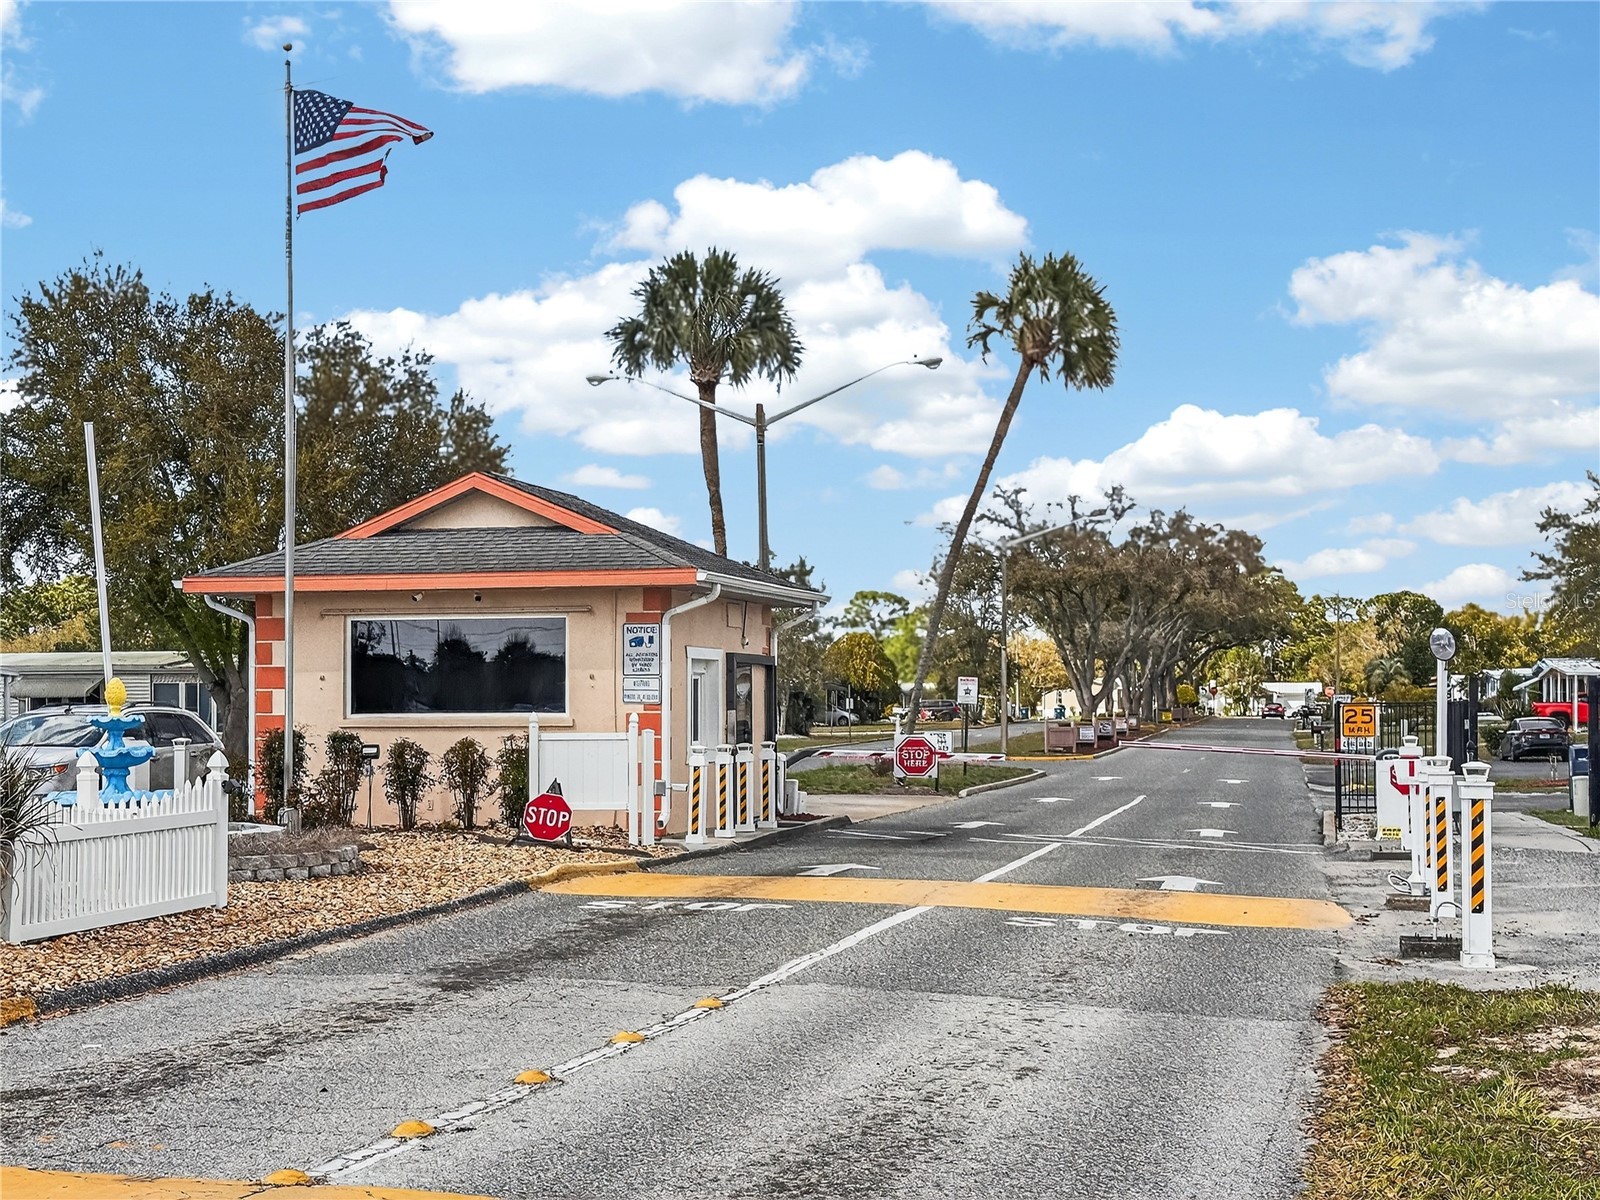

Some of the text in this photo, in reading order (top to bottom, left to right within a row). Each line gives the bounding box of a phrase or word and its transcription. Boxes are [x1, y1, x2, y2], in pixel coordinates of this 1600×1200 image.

[626, 626, 658, 634] NOTICE
[1344, 708, 1373, 724] 25
[901, 749, 930, 760] STOP
[526, 806, 570, 828] STOP
[577, 900, 793, 912] STOP
[1001, 916, 1231, 937] STOP
